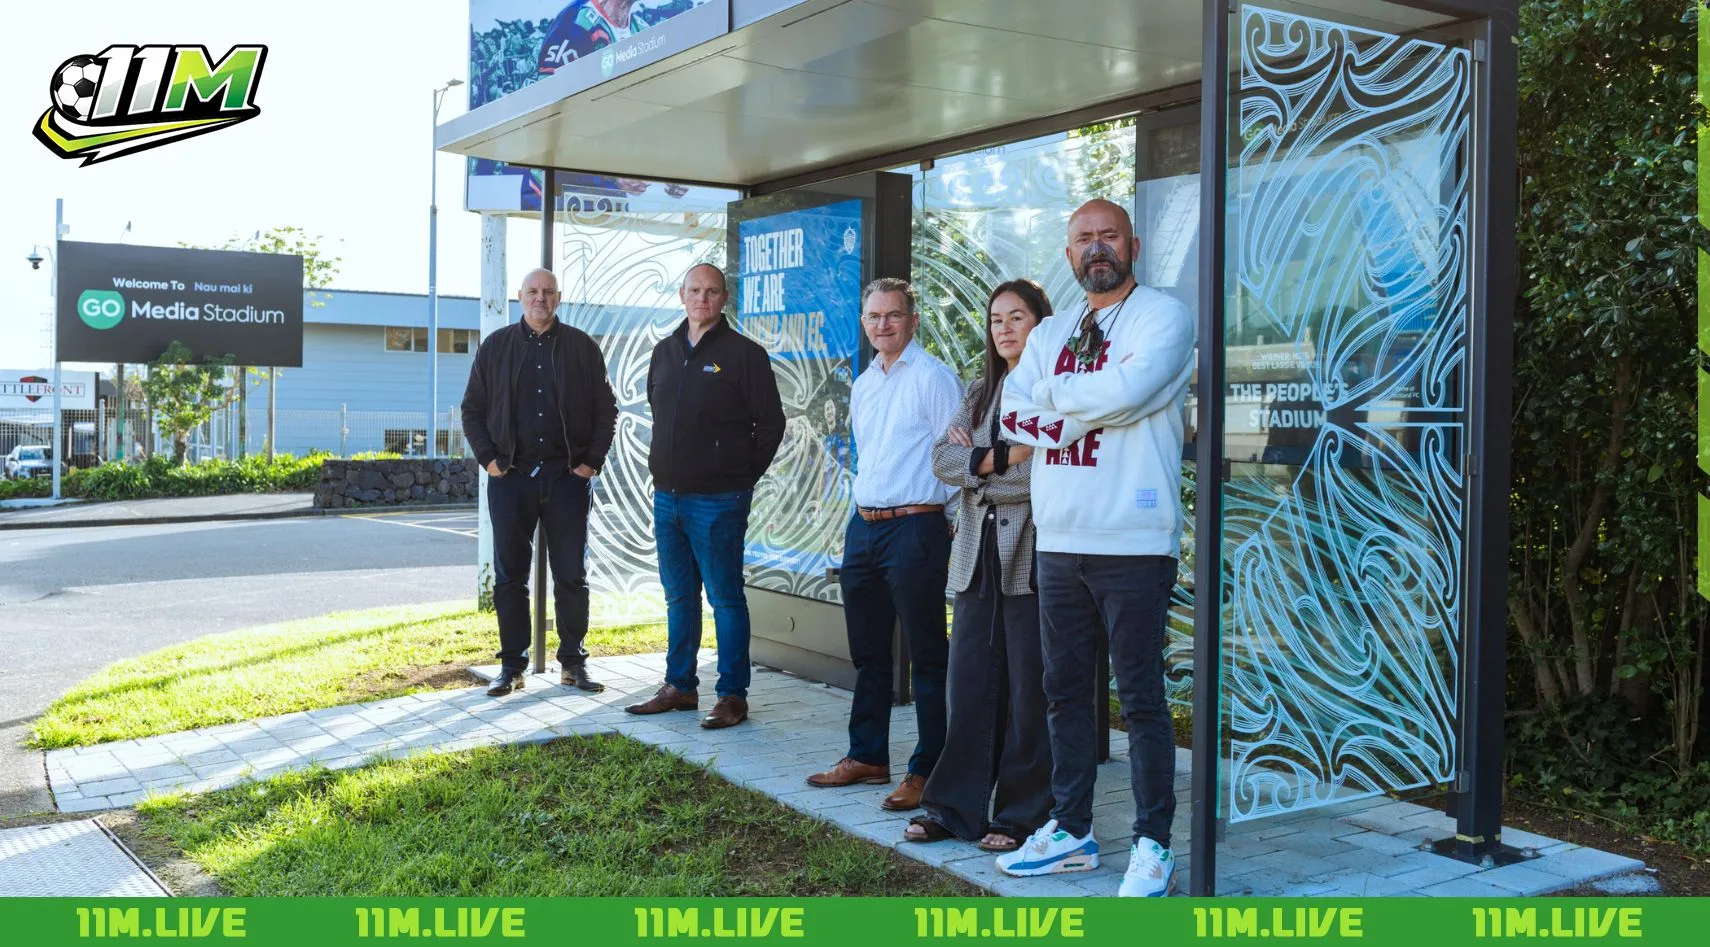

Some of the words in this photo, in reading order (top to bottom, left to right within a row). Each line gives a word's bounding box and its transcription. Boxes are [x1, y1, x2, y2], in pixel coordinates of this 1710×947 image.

[602, 54, 614, 69] GO
[616, 44, 637, 64] Media
[637, 34, 666, 55] Stadium
[743, 228, 804, 274] TOGETHER
[112, 277, 168, 290] Welcome
[170, 280, 185, 291] To
[194, 282, 217, 292] Nau
[219, 282, 241, 293] mai
[243, 283, 253, 294] ki
[743, 276, 761, 313] WE
[762, 273, 785, 312] ARE
[82, 298, 121, 317] GO
[131, 300, 200, 321] Media
[203, 303, 284, 324] Stadium
[1230, 384, 1262, 401] THE
[1249, 409, 1327, 428] STADIUM
